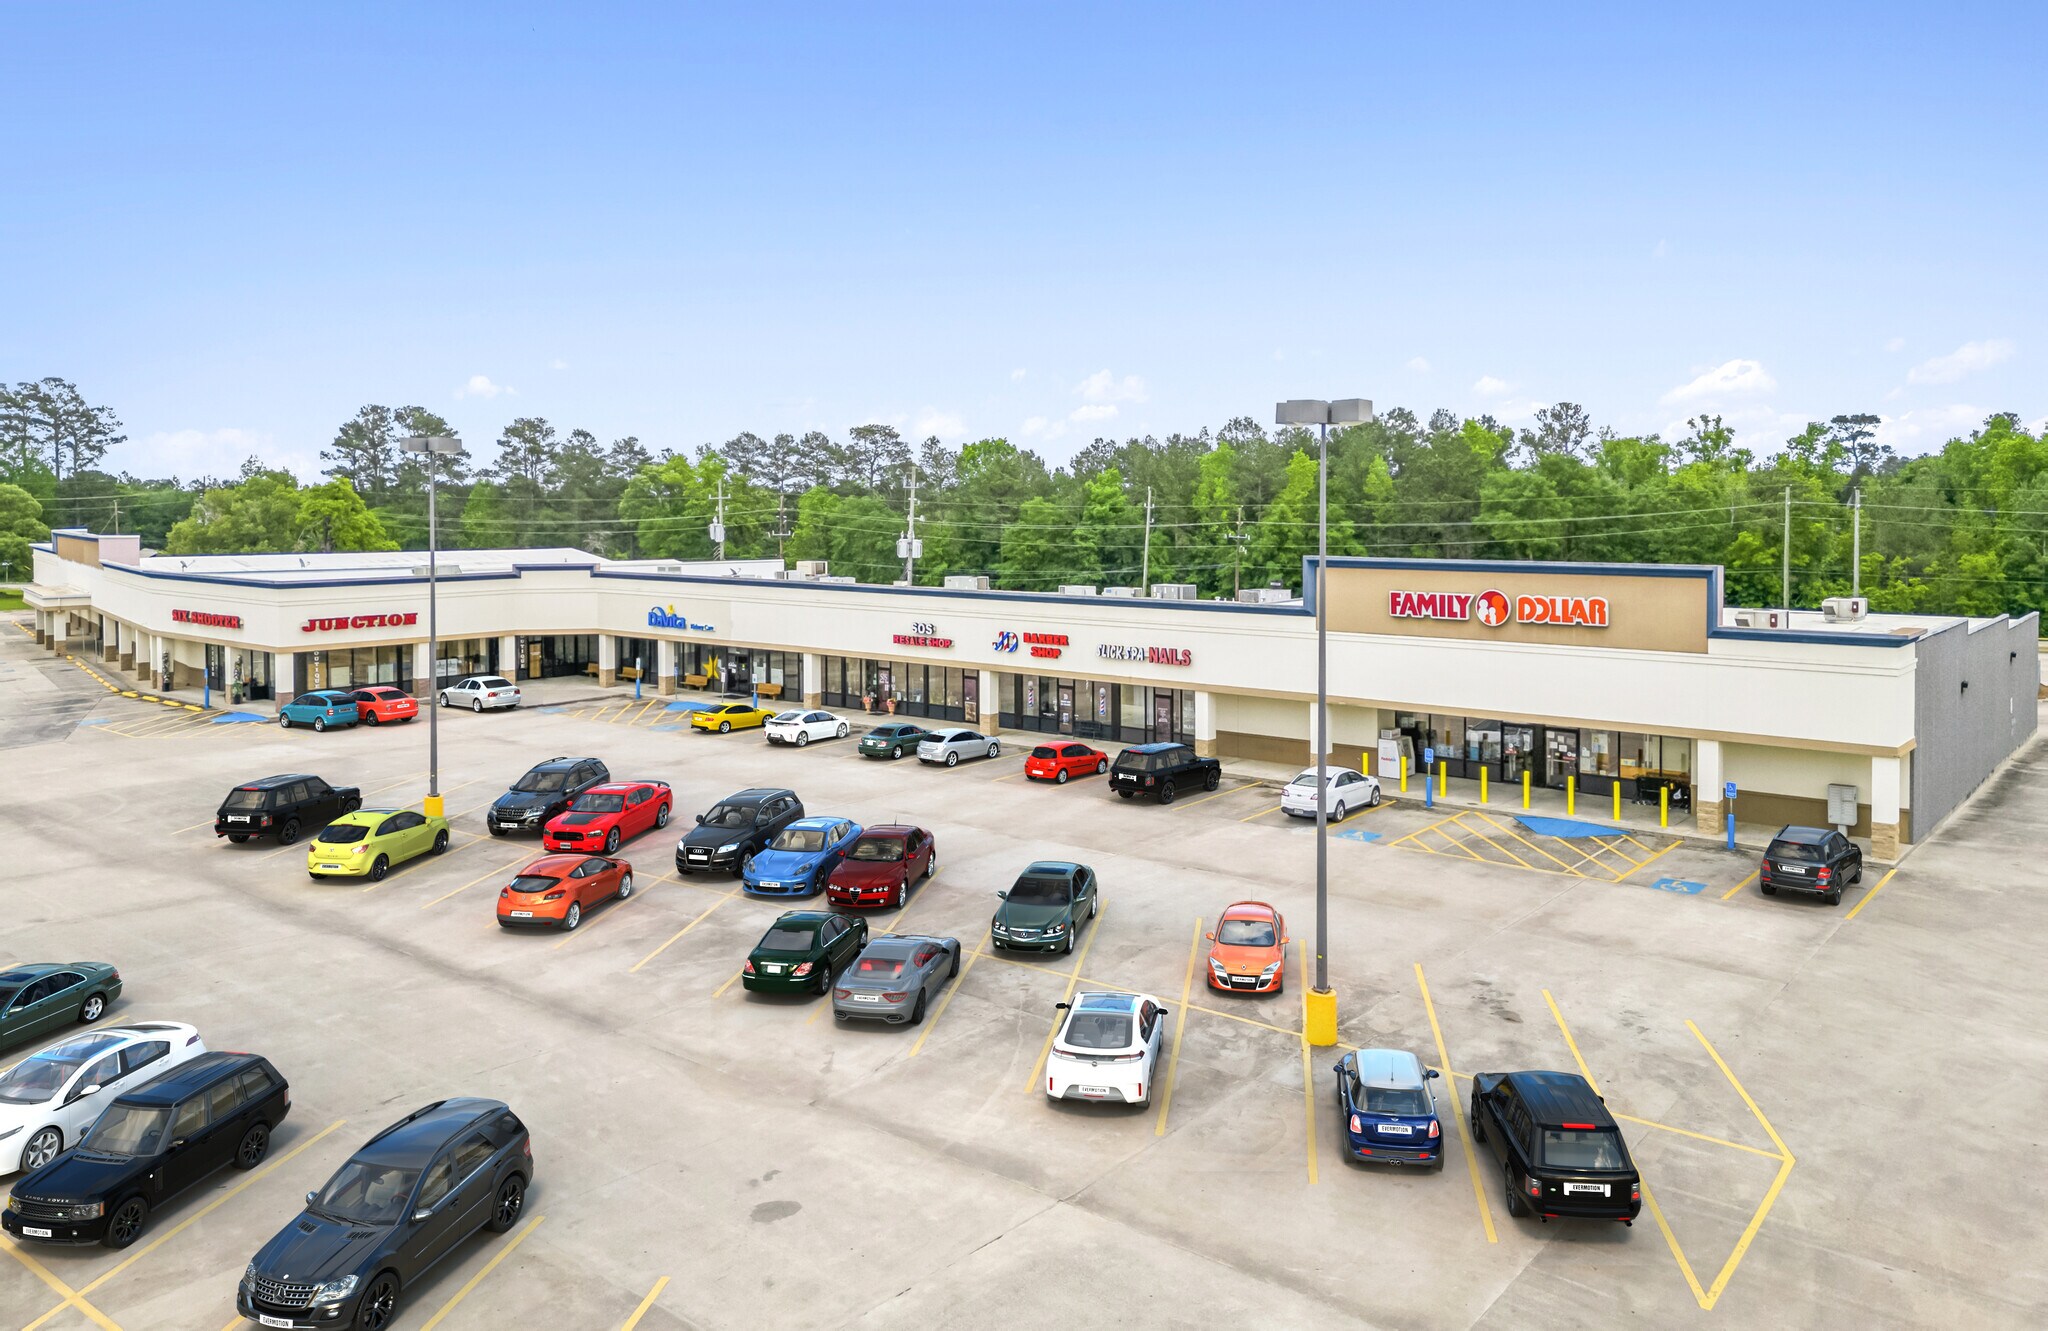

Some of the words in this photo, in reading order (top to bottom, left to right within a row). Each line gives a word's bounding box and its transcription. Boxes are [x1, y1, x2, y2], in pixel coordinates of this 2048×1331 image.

[1389, 591, 1475, 620] FAMILY
[1516, 595, 1608, 626] DOLLAR
[172, 609, 190, 623] SIX
[191, 611, 241, 629] SHOOTER
[301, 612, 418, 632] JUNCTION
[648, 606, 687, 630] DaVita
[912, 622, 936, 635] SOS
[892, 634, 928, 647] RESALE
[928, 637, 953, 649] SHOP
[992, 631, 1019, 653] JD
[1023, 632, 1069, 646] BARBER
[1030, 646, 1062, 659] SHOP
[1097, 643, 1125, 660] SLICK
[1125, 646, 1146, 661] SPA
[1148, 646, 1192, 667] NAILS
[1381, 1125, 1409, 1133] EVERMOTION
[25, 1228, 49, 1236] EVERMOTION
[262, 1316, 290, 1327] EVERMOTION
